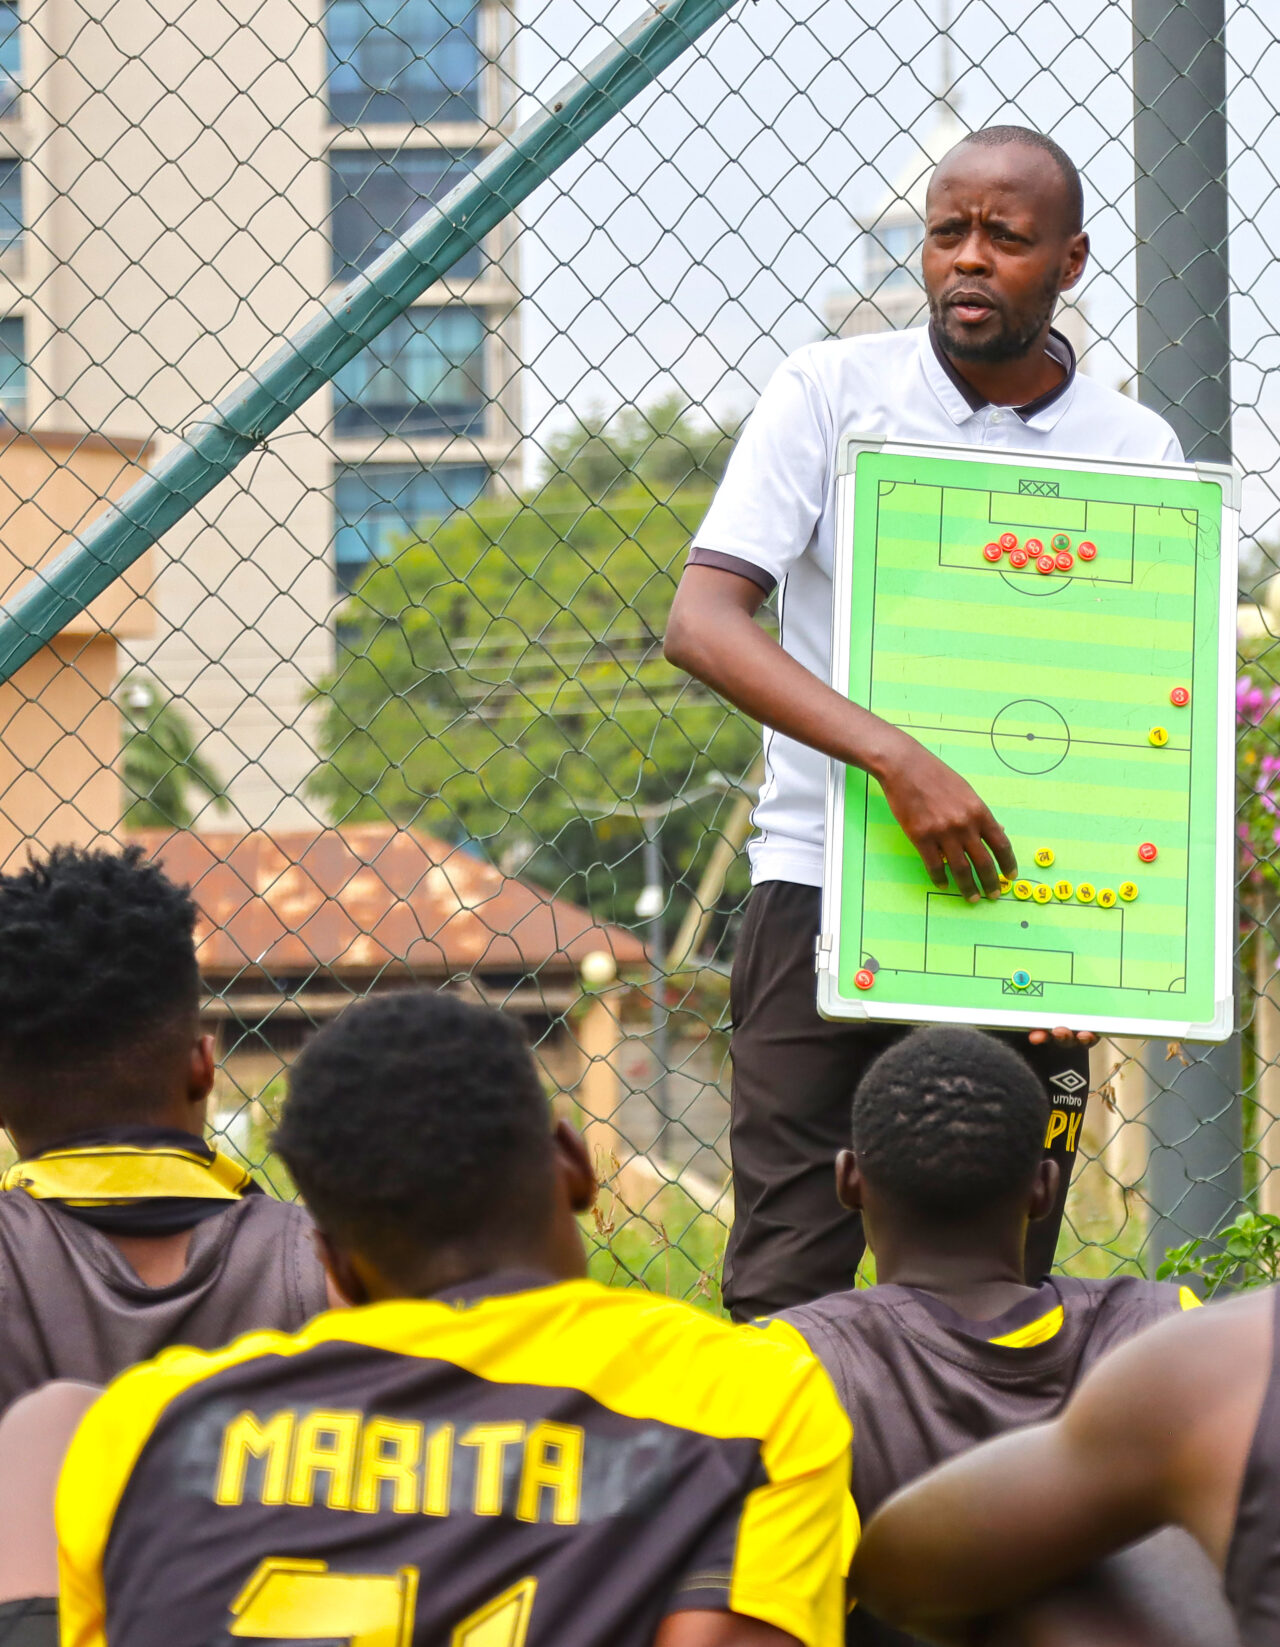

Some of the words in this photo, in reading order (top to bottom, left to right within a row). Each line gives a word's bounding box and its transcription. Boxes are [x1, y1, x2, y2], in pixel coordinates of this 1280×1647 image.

[1029, 542, 1040, 553] 8
[1174, 690, 1185, 702] 3
[1153, 729, 1163, 741] 7
[1140, 845, 1154, 858] 11
[1038, 887, 1047, 898] 5
[1058, 884, 1069, 894] 11
[1081, 886, 1091, 898] 8
[1124, 885, 1134, 896] 2
[1053, 1094, 1082, 1106] umbro
[1044, 1109, 1082, 1153] PK
[214, 1408, 584, 1525] MARITA
